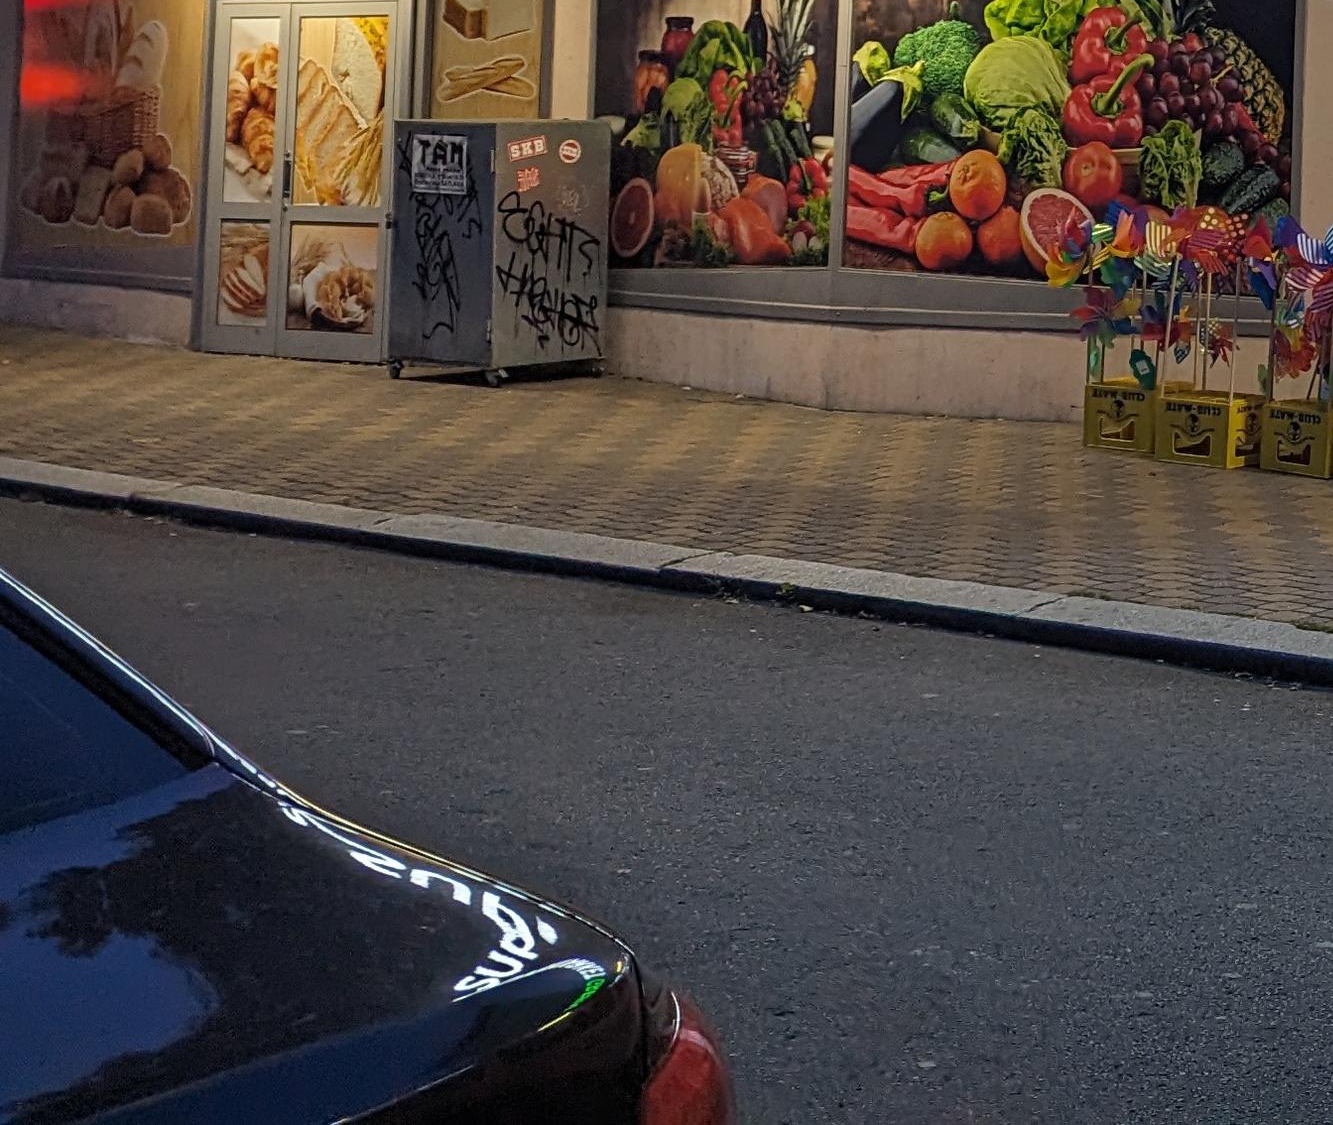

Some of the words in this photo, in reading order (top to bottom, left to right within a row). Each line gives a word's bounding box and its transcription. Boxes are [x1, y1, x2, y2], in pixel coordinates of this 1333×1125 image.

[1091, 387, 1146, 402] CLUB-MATE
[1165, 401, 1222, 417] CLUB-MATE
[1269, 409, 1322, 424] CLUB-MATE
